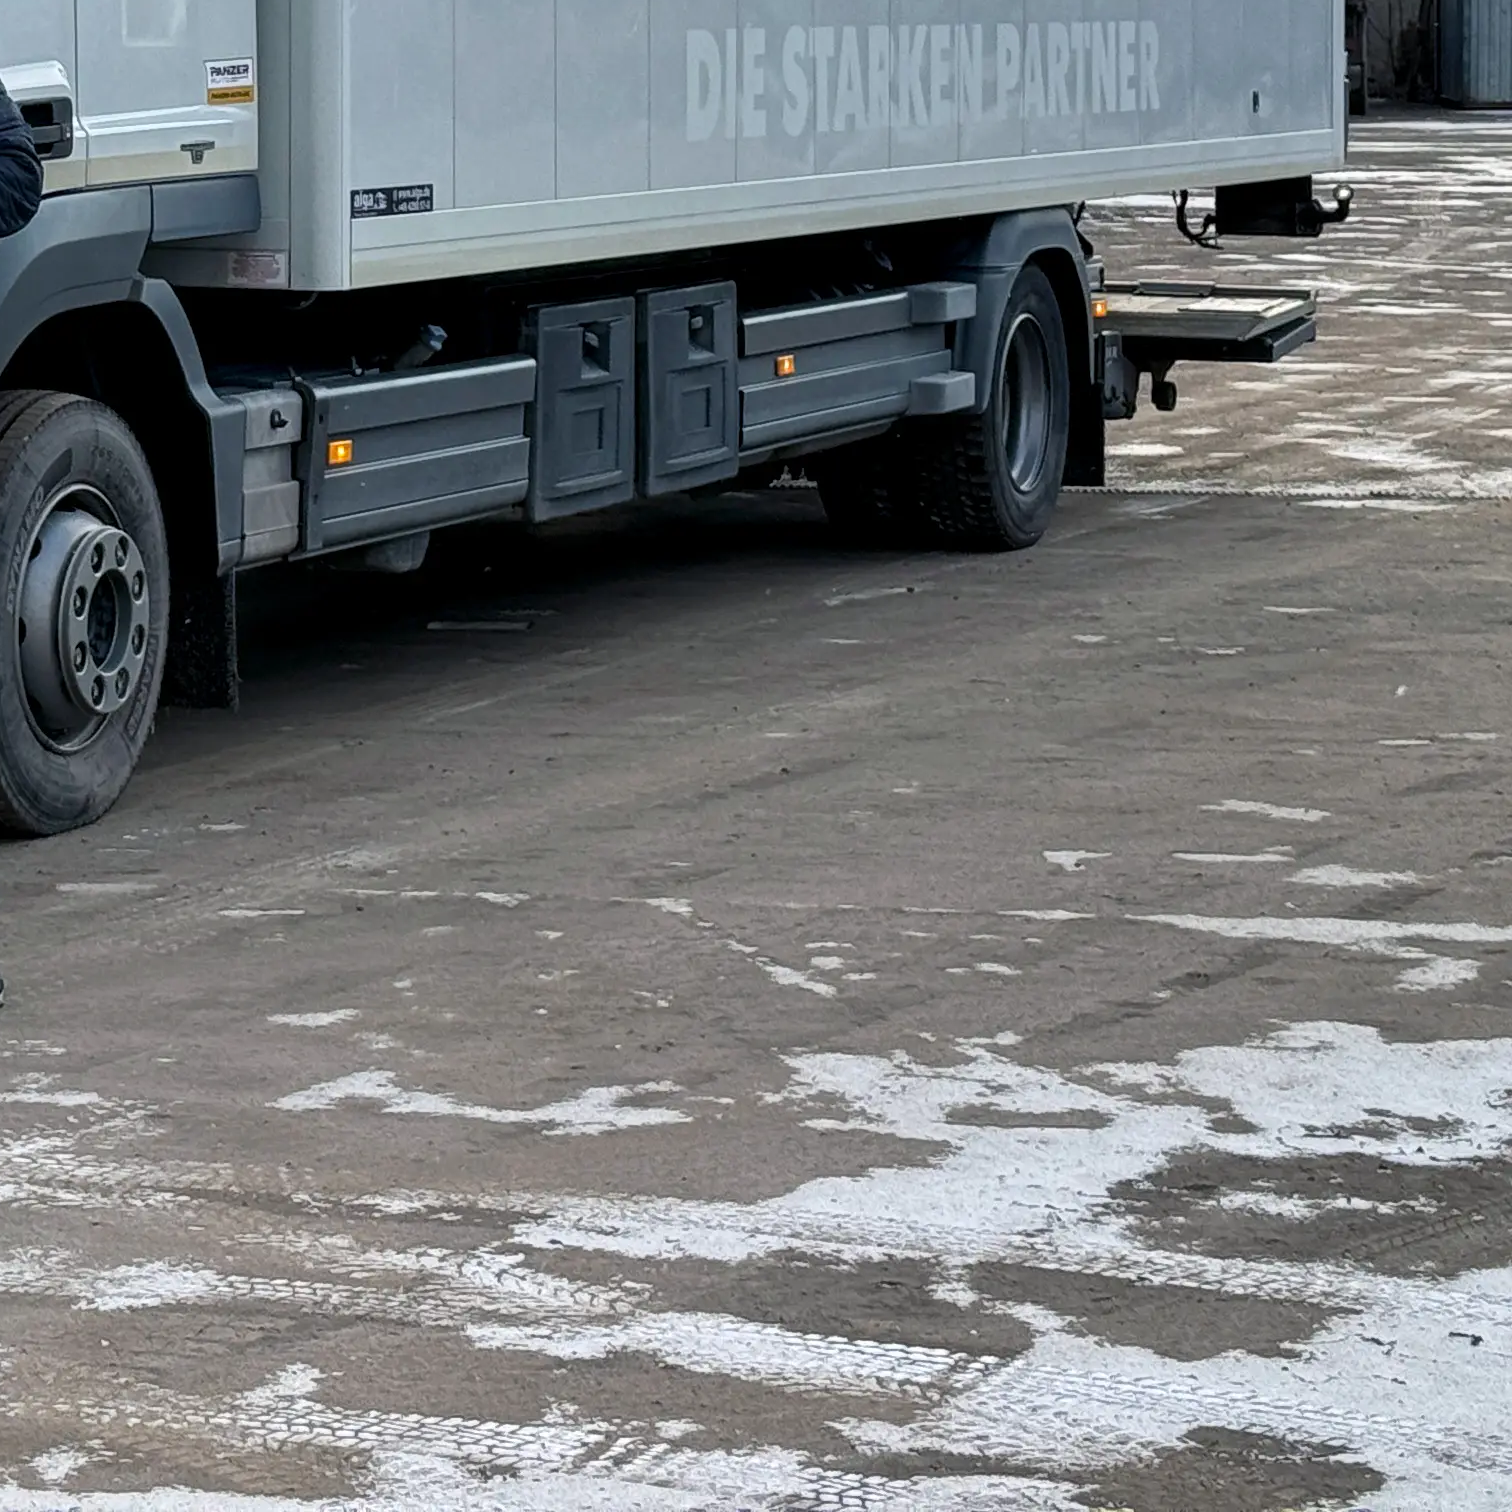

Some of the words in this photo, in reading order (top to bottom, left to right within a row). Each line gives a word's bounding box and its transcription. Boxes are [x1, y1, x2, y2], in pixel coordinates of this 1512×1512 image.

[686, 26, 767, 141] DIE
[782, 23, 983, 137] STARKEN
[996, 20, 1160, 121] PARTNER
